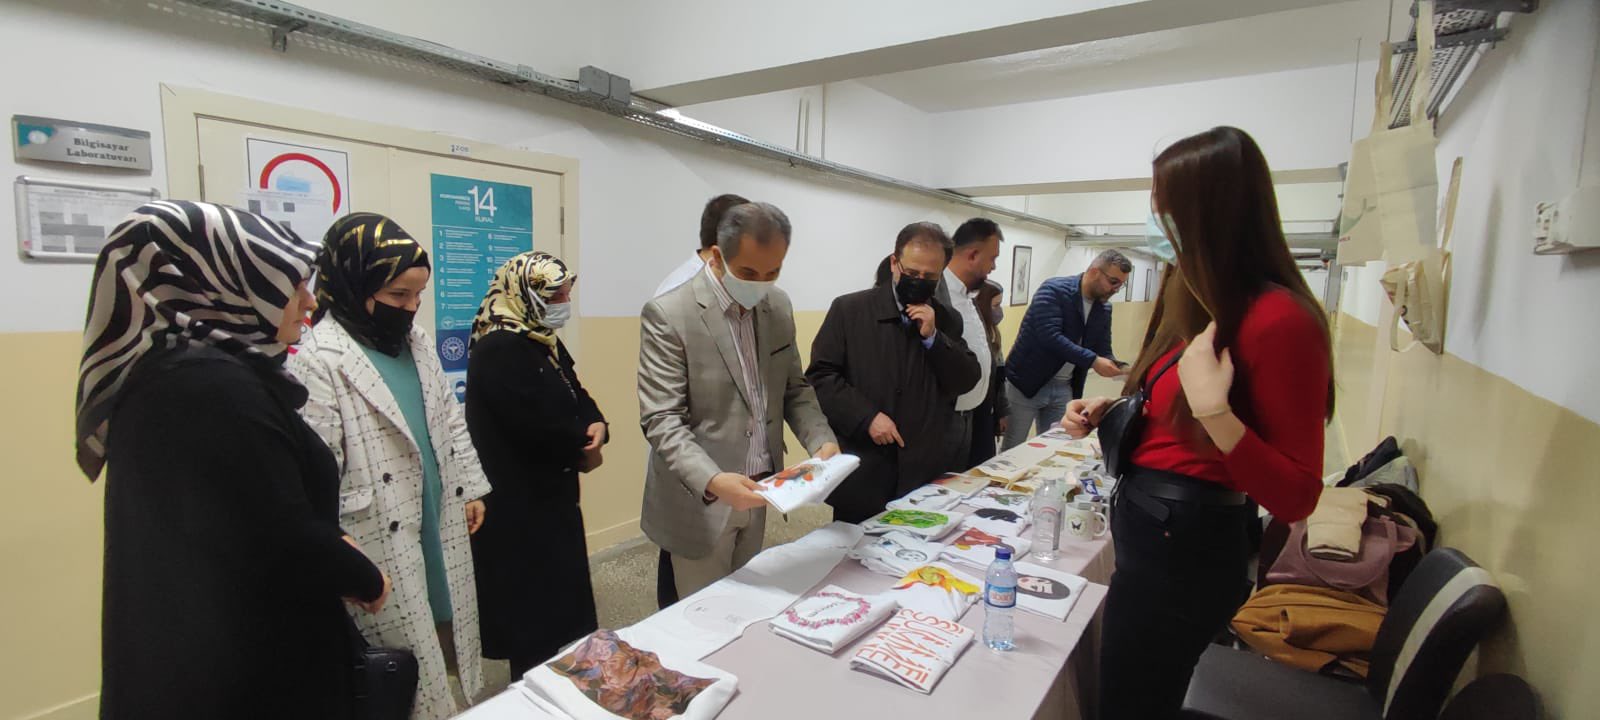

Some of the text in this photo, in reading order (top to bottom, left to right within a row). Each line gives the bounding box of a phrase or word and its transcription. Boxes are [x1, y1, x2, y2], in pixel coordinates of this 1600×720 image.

[74, 138, 129, 151] Bilgisayar
[66, 148, 137, 162] Laboratuvarı
[467, 185, 497, 217] 14
